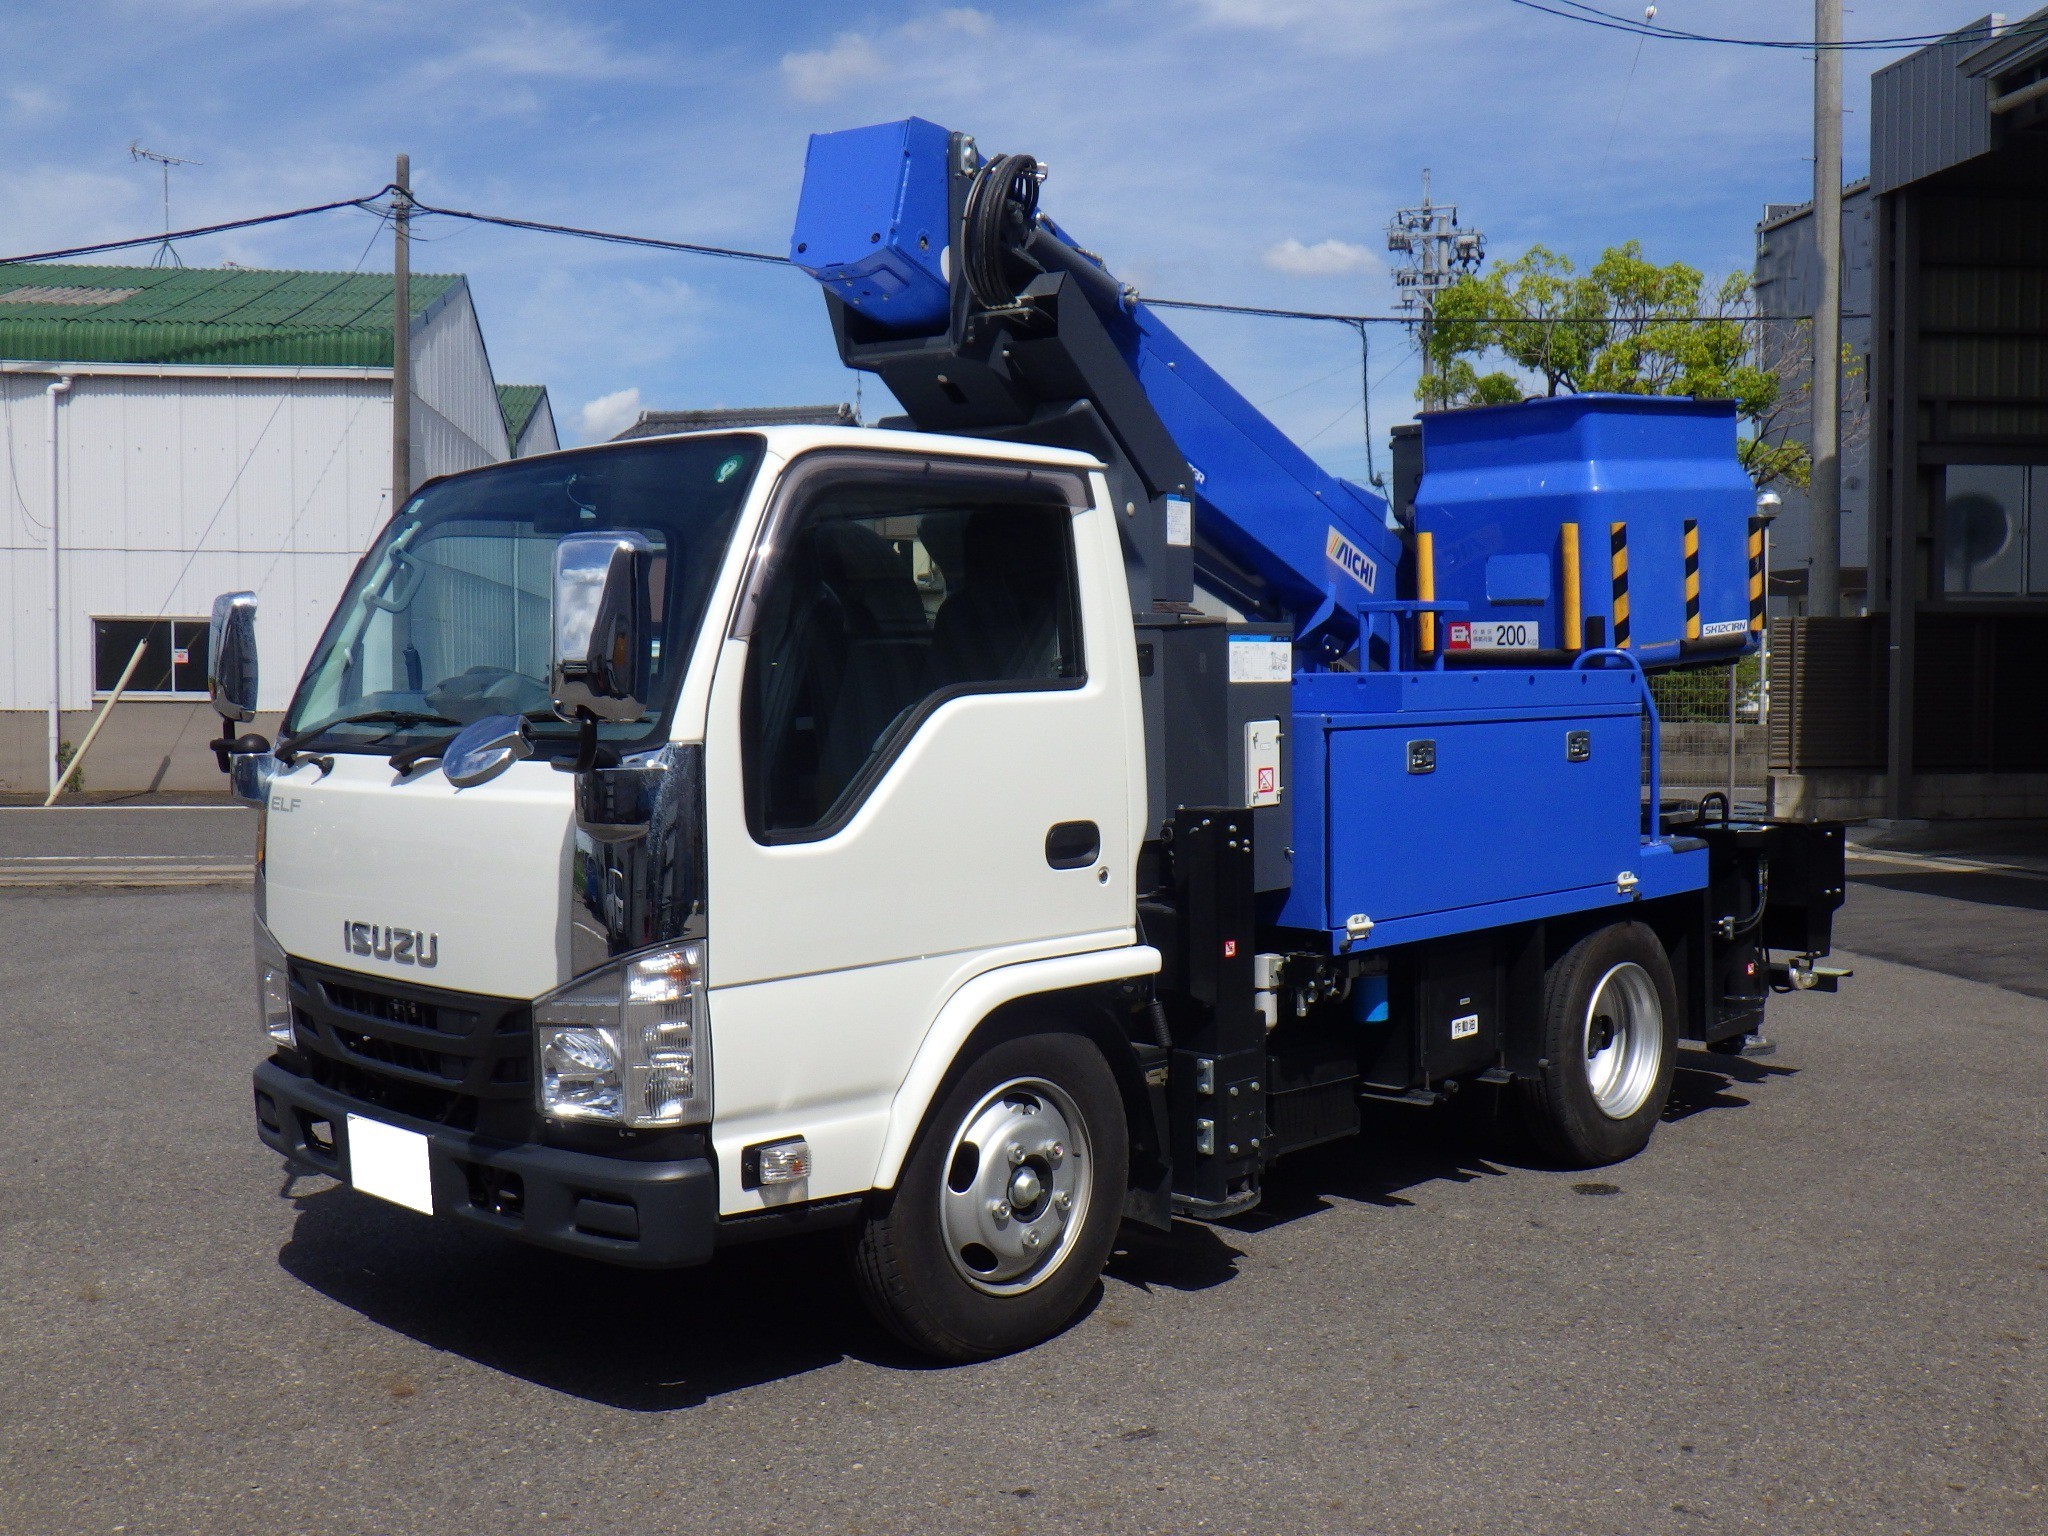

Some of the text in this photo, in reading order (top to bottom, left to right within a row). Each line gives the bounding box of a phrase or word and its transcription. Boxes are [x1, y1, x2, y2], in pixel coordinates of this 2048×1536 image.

[1335, 541, 1374, 587] AICHI
[1496, 624, 1526, 646] 200
[271, 795, 302, 813] ELF
[343, 919, 438, 968] ISUZU
